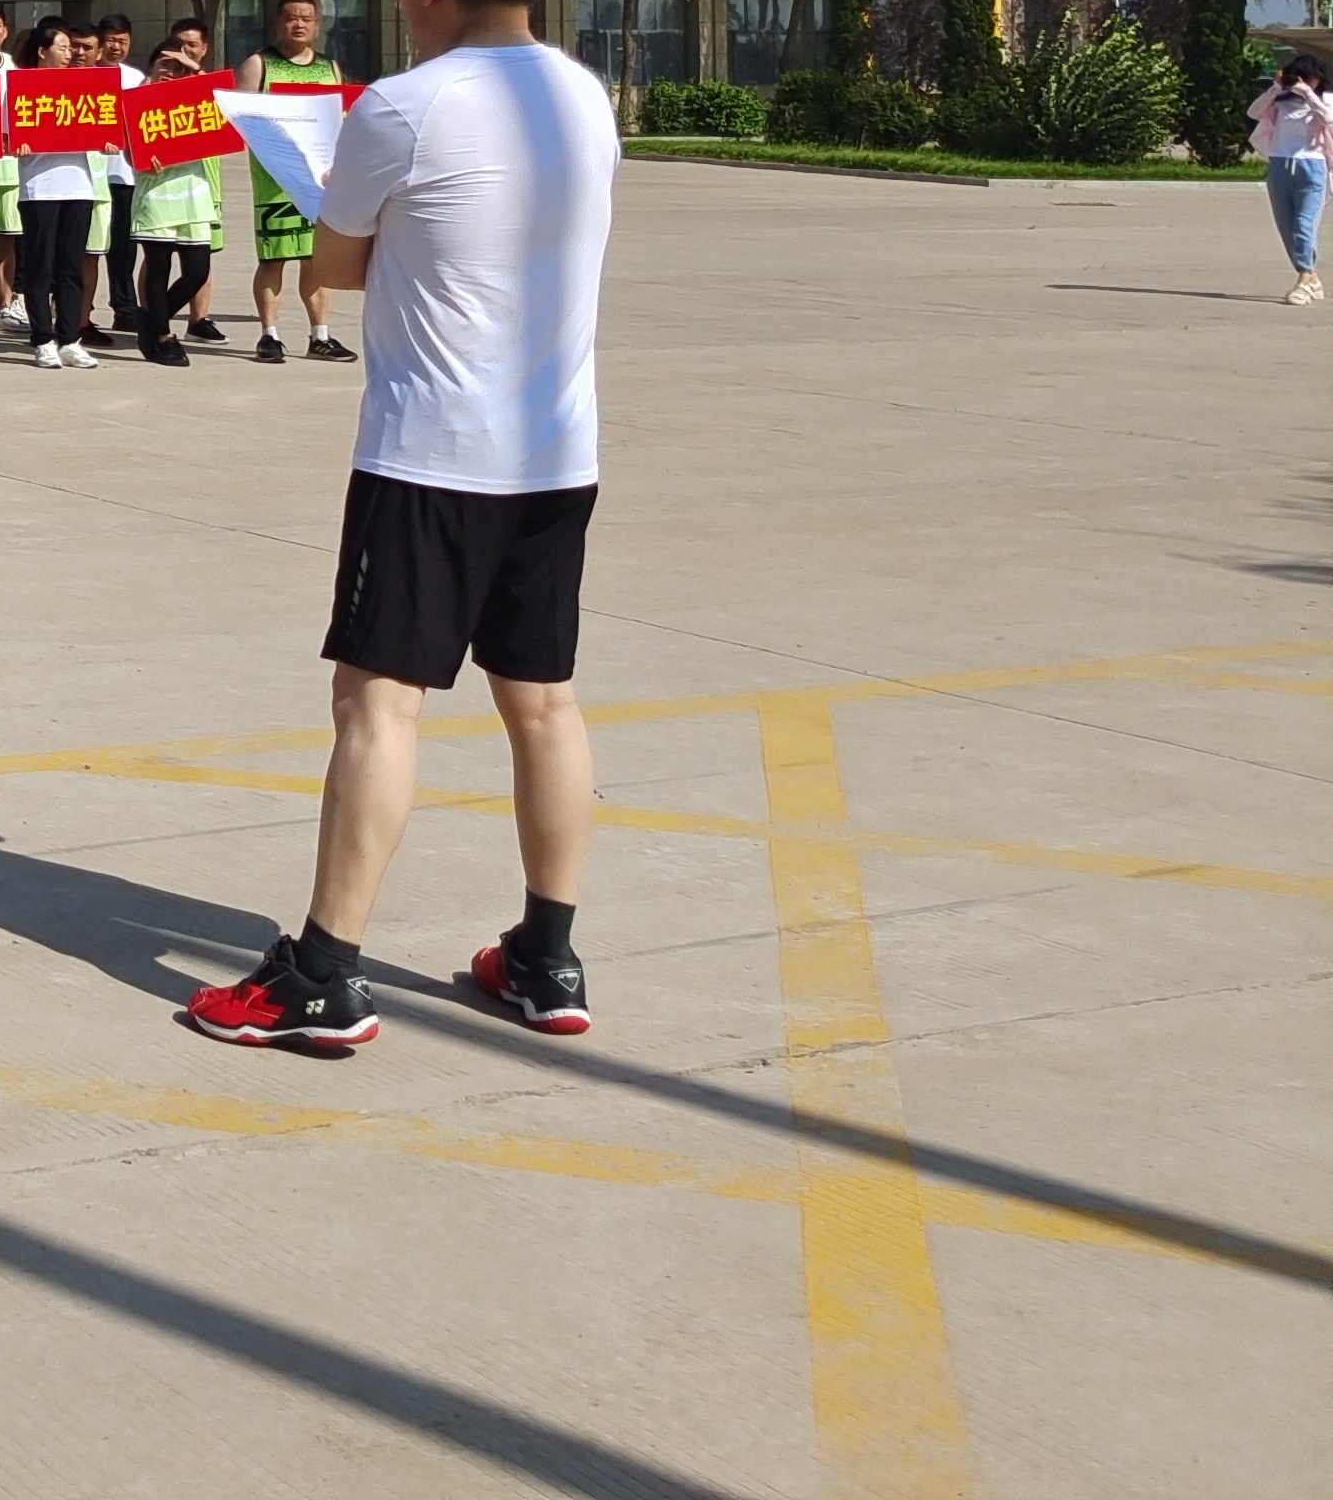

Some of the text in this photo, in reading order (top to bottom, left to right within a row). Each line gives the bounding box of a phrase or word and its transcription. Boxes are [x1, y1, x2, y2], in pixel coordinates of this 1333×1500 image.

[14, 93, 118, 128] 生产办公室
[138, 99, 229, 145] 供应部
